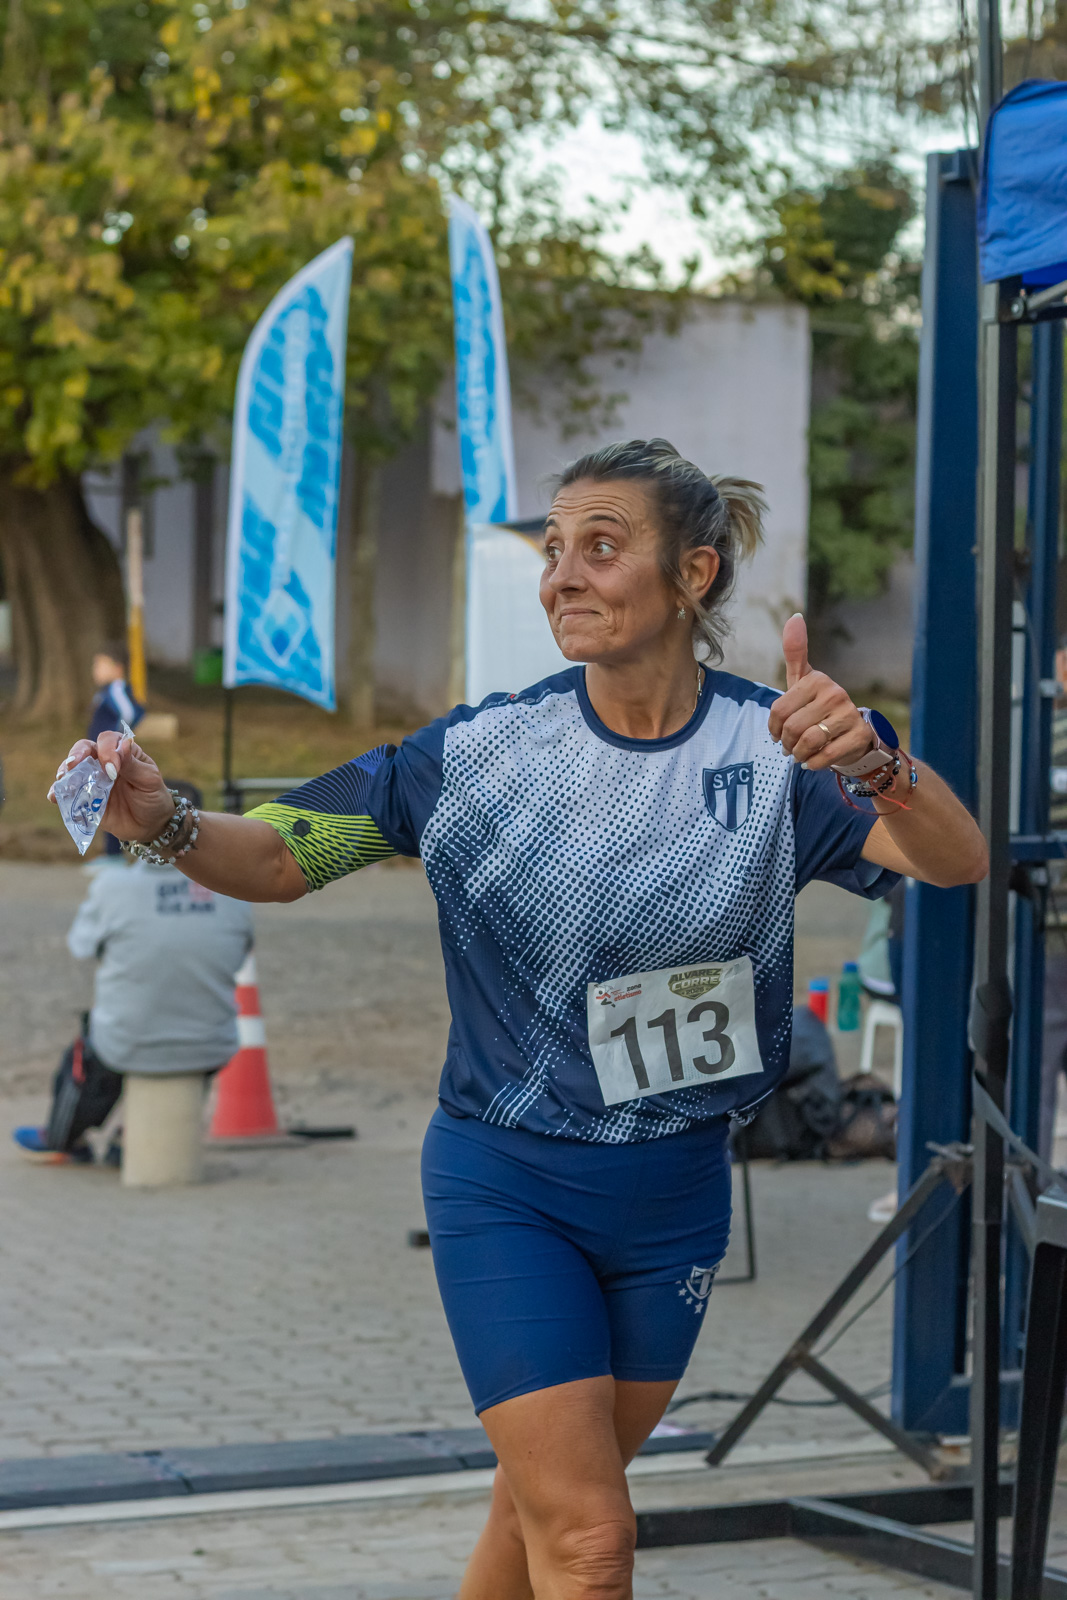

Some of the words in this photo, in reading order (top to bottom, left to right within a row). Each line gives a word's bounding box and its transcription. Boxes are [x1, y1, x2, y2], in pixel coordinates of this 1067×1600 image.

[712, 767, 750, 789] SFC
[671, 968, 722, 981] ALVAREZ
[672, 976, 719, 991] CORRE
[610, 1001, 736, 1090] 113
